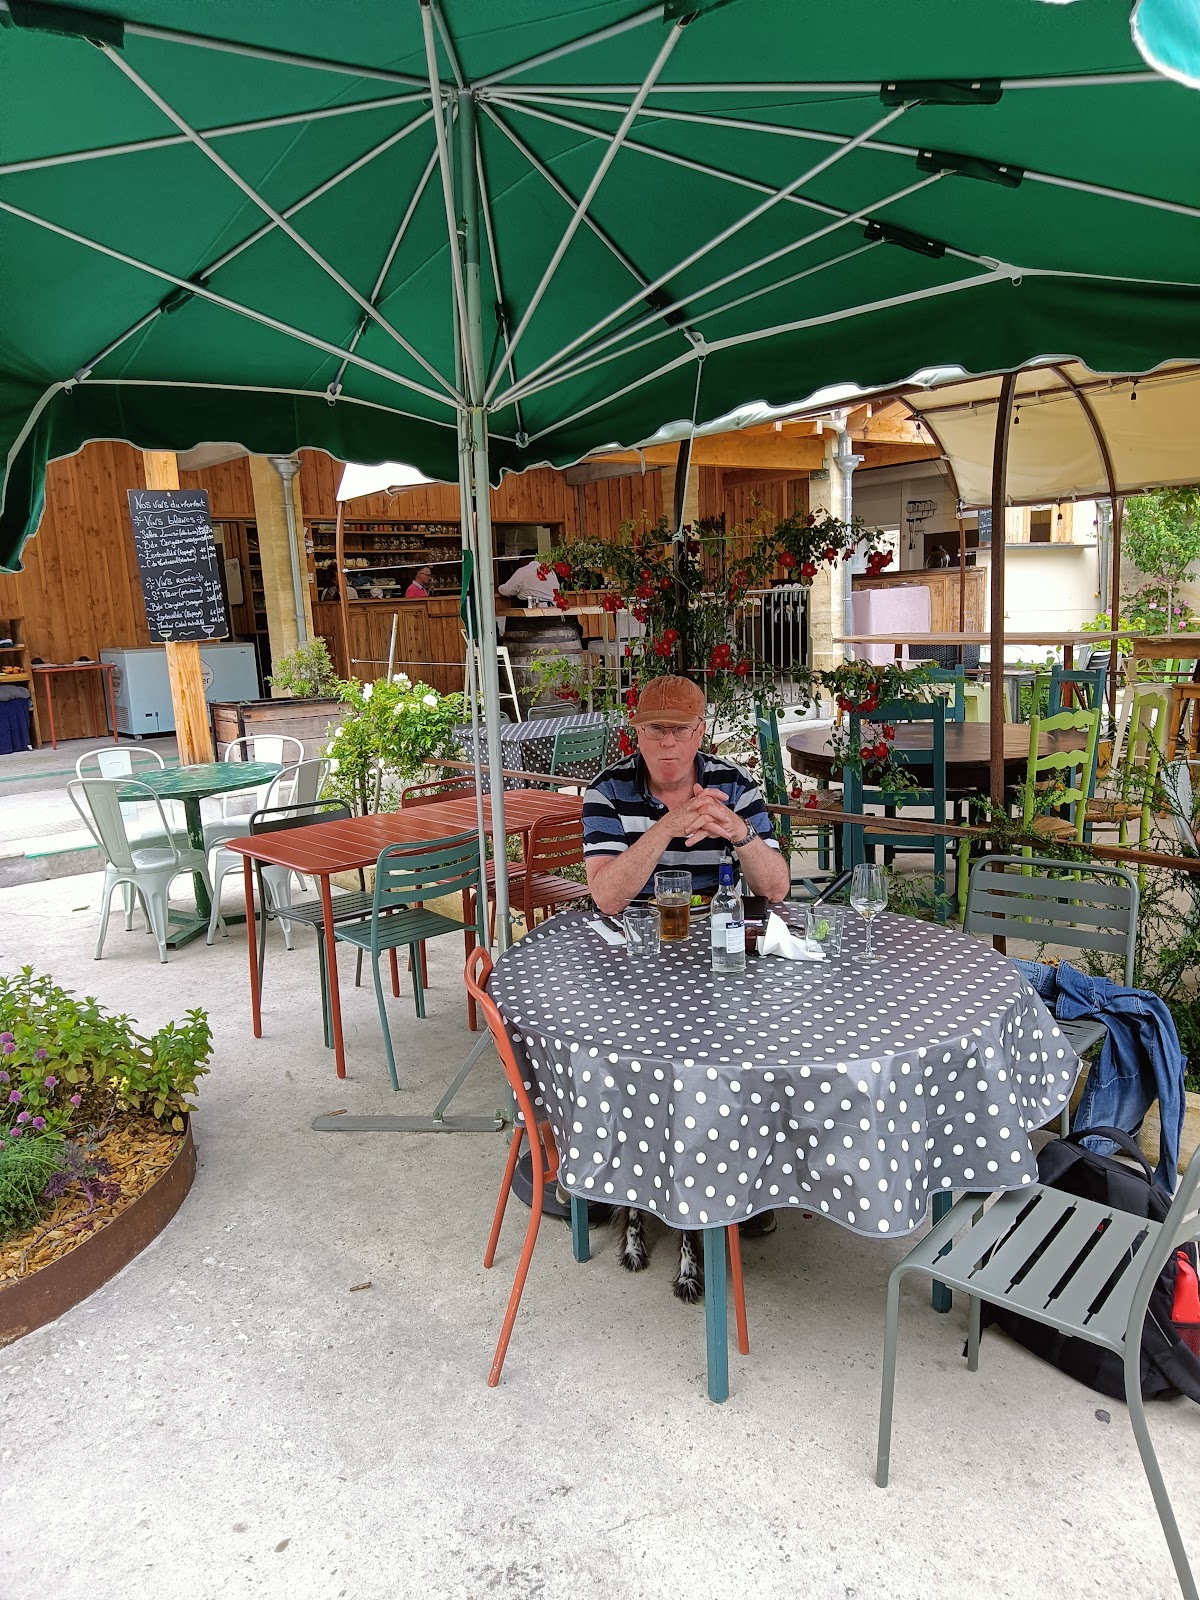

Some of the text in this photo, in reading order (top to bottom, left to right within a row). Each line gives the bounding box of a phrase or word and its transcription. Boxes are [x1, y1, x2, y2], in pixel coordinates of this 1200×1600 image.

[134, 493, 151, 510] Nos
[170, 499, 180, 509] du
[144, 514, 196, 526] Vins blancs
[155, 576, 173, 588] Vins
